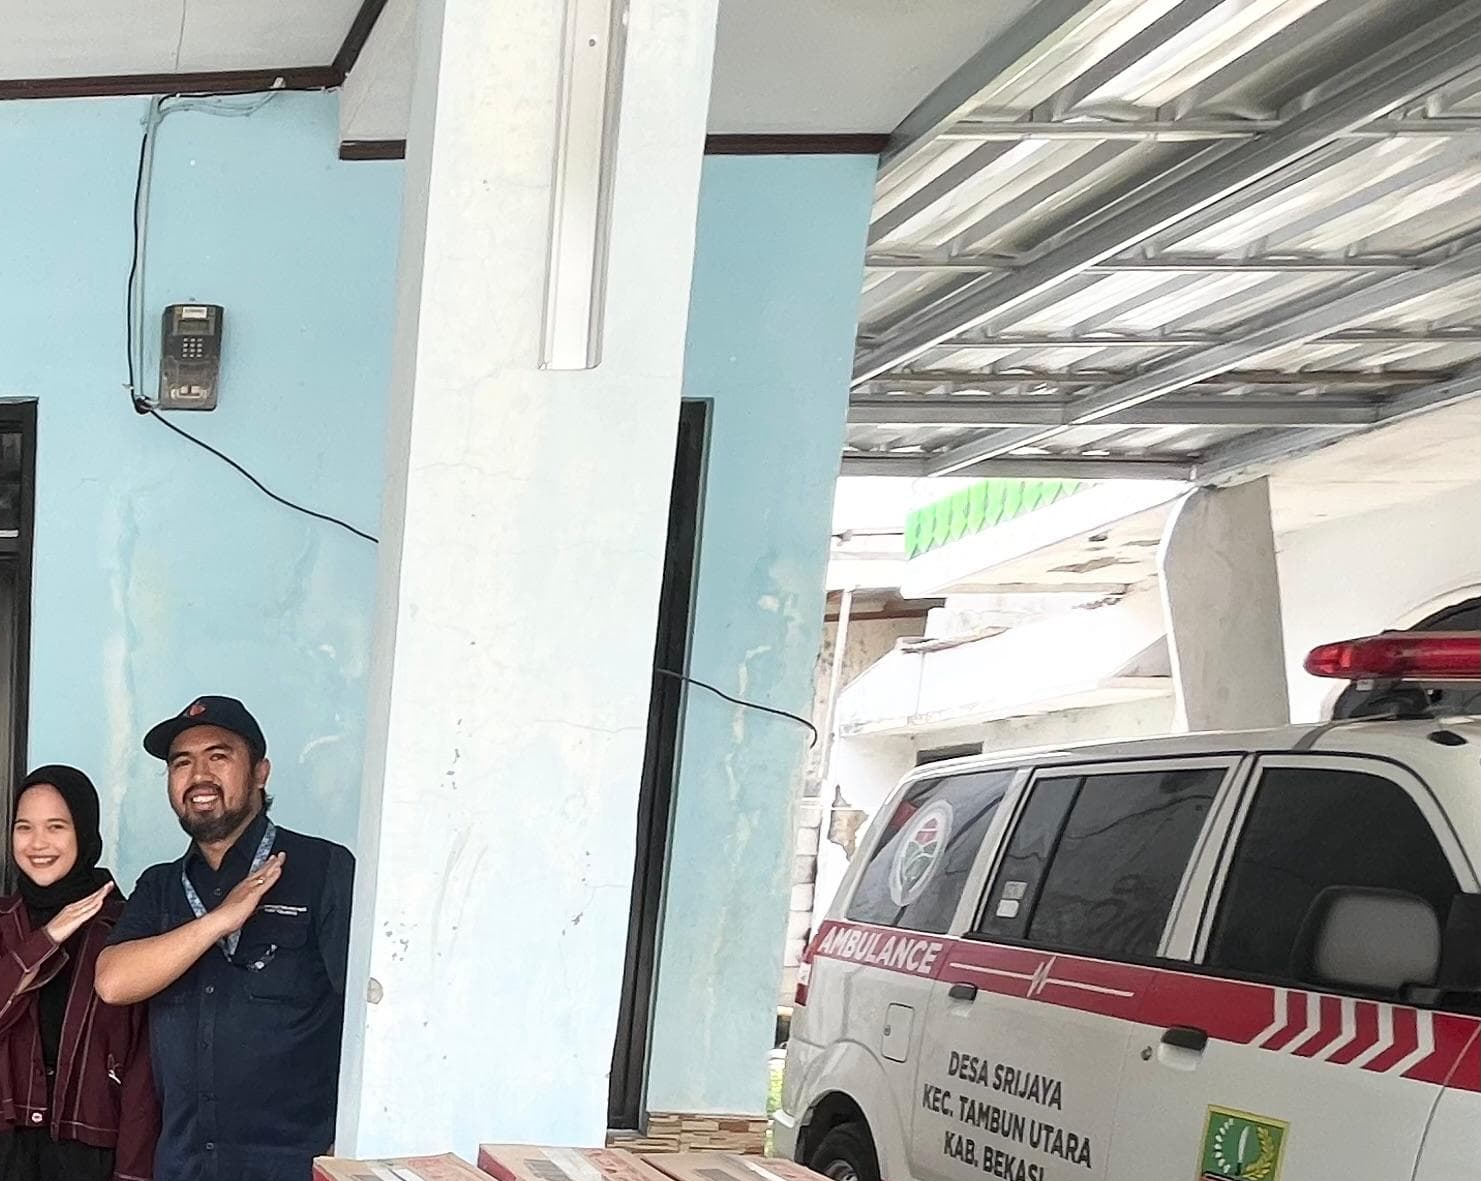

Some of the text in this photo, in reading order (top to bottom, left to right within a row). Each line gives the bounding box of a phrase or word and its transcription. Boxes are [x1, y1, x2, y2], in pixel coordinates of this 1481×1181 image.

[817, 926, 943, 975] AMBULANCE
[947, 1051, 1062, 1110] DESA SRIJAYA
[923, 1084, 1092, 1169] KEC. TAMBUN UTARA
[944, 1131, 978, 1167] KAB.
